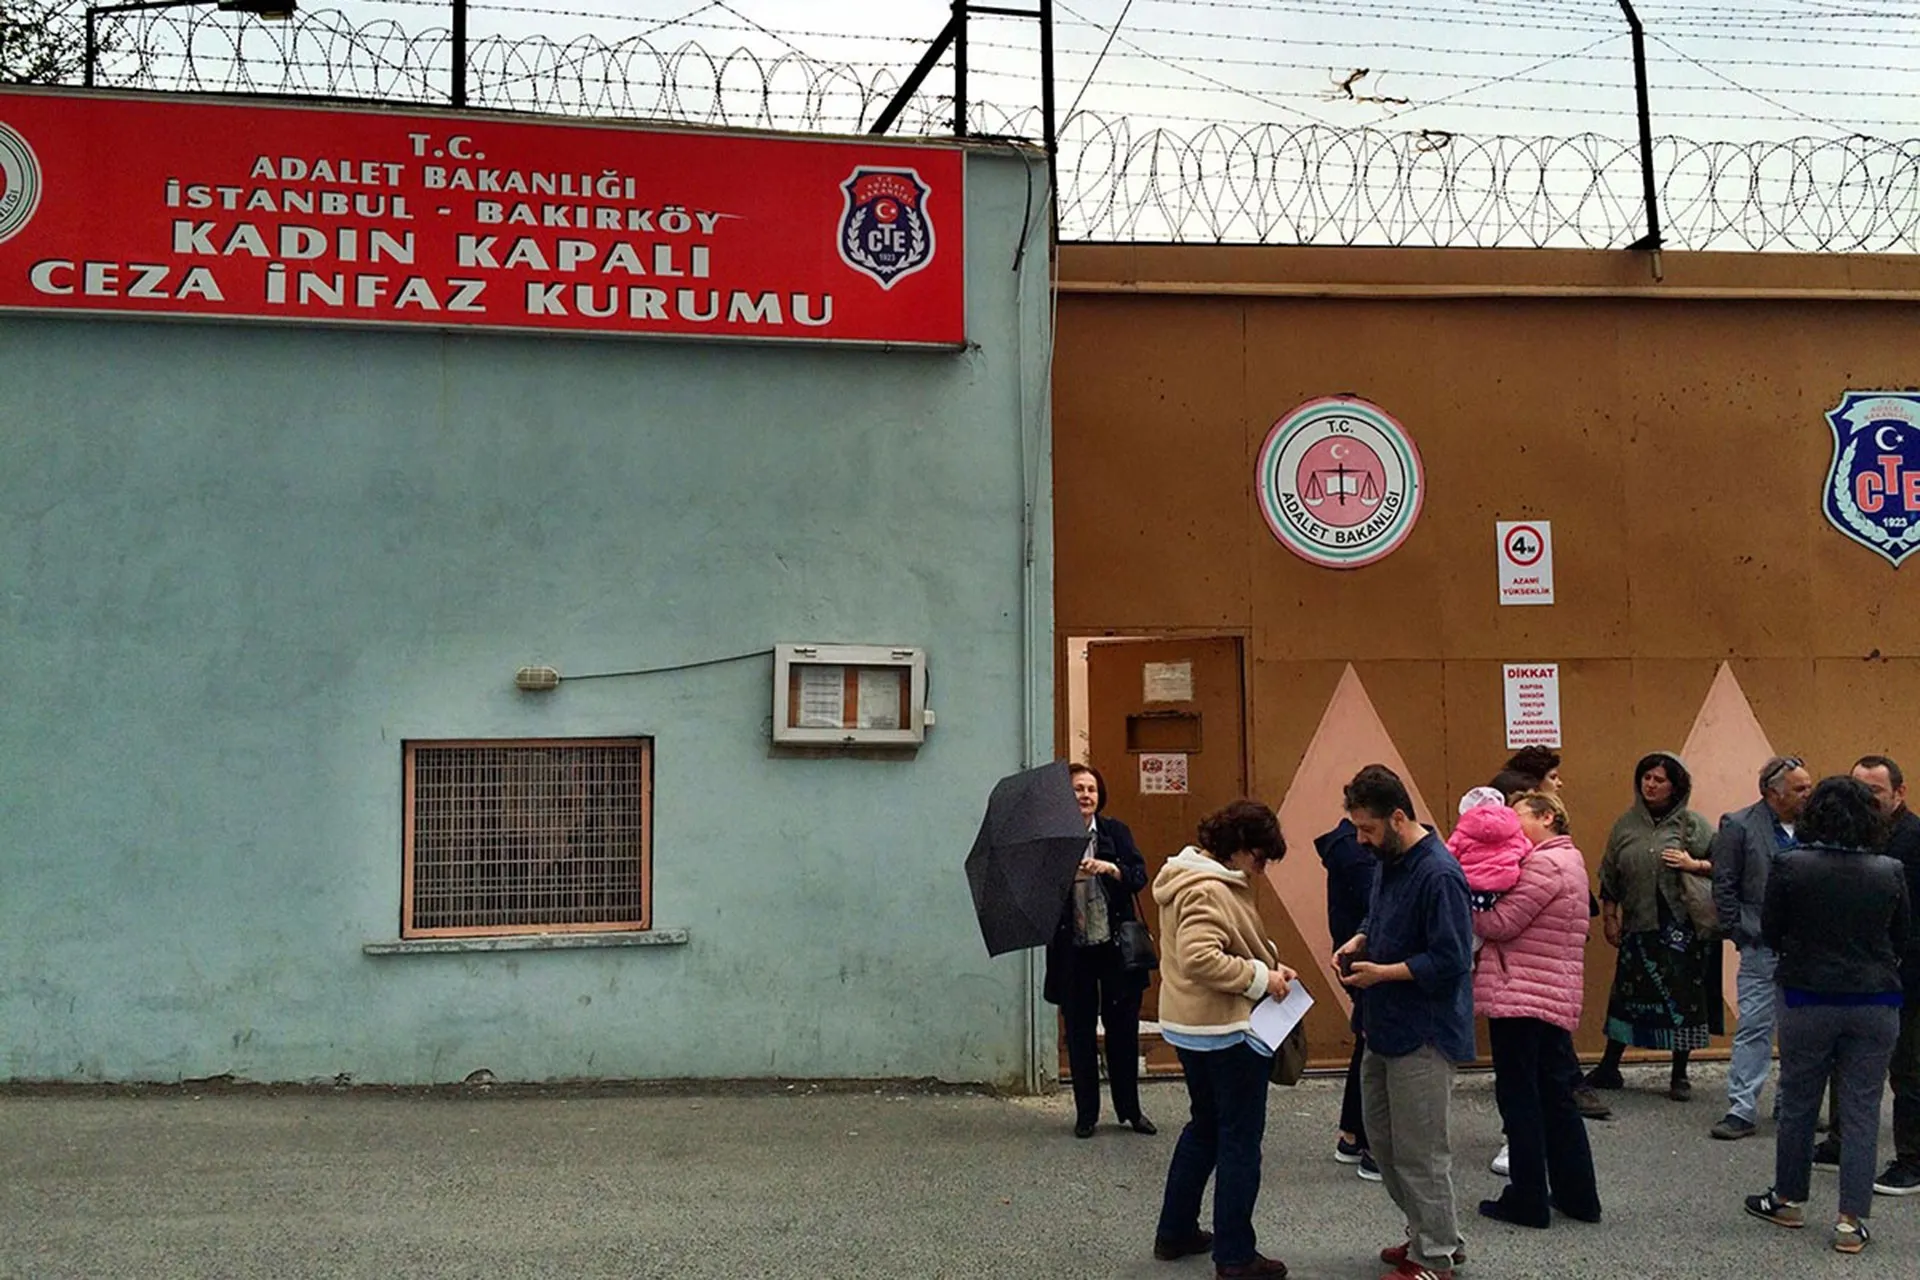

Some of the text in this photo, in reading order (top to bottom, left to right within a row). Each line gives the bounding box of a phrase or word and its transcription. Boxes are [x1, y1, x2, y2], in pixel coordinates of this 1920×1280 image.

[408, 133, 486, 160] T.C.
[251, 156, 636, 200] ADALET BAKANLIĞI
[167, 179, 415, 220] İSTANBUL
[477, 202, 719, 235] BAKIRKÖY
[173, 220, 710, 278] KADIN KAPALI
[30, 260, 833, 326] CEZA İNFAZ KURUMU
[1326, 420, 1353, 433] T.C.
[1282, 491, 1330, 540] ADALET
[1882, 517, 1908, 528] 1923
[1507, 667, 1555, 679] DİKKAT
